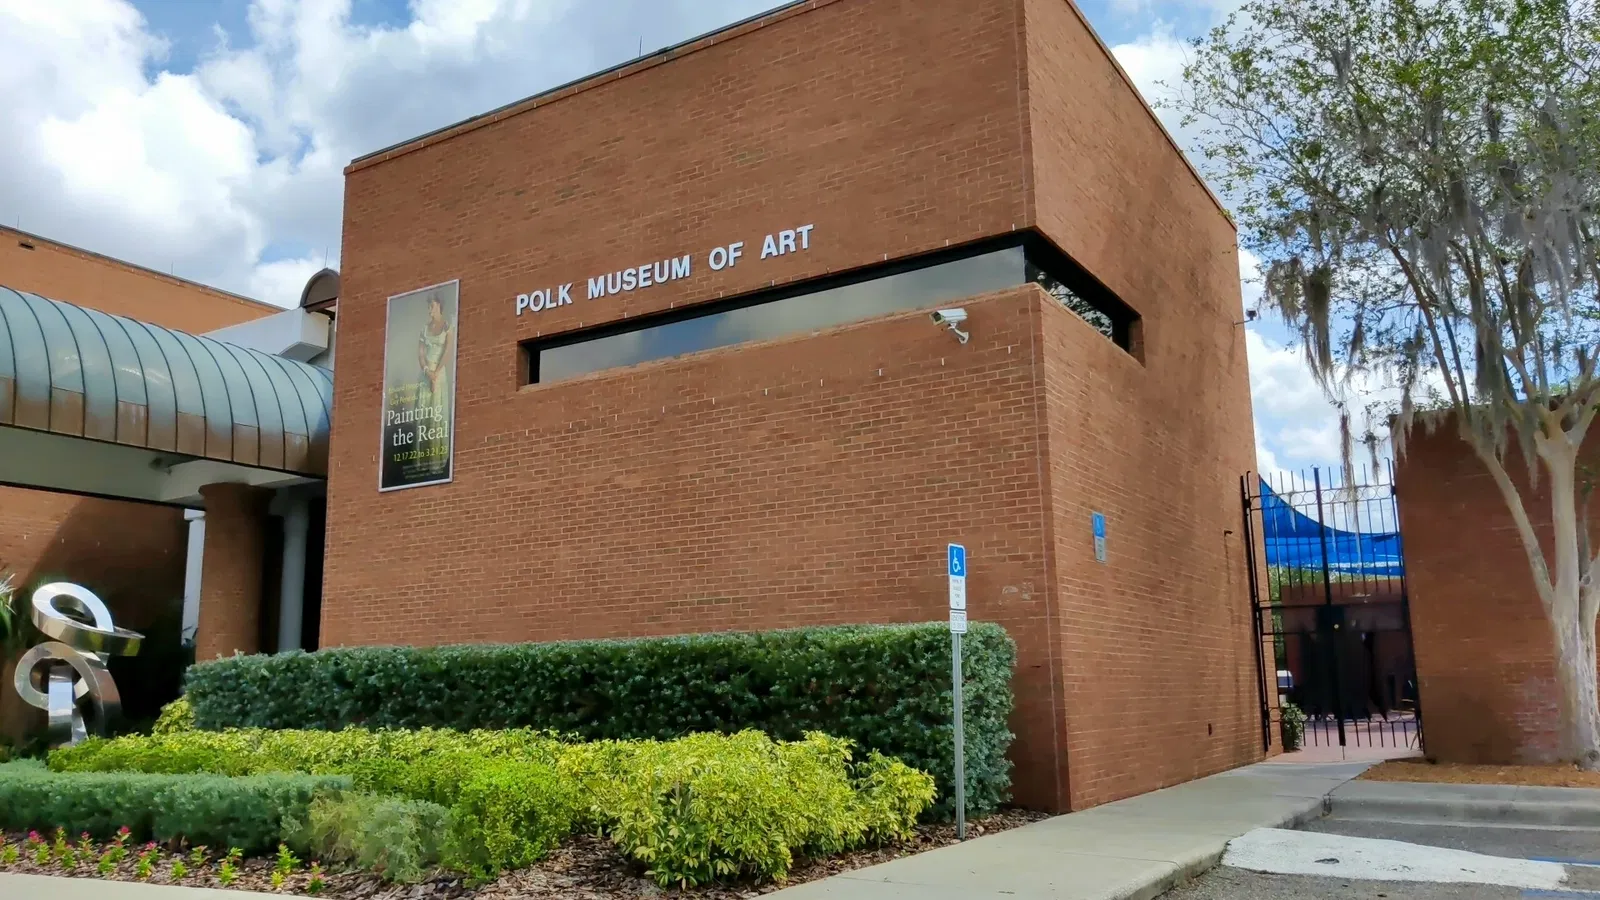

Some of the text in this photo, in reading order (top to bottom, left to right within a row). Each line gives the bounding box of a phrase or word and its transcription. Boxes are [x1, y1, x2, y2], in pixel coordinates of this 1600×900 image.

[516, 223, 814, 316] POLK MUSEUM OF ART
[387, 404, 443, 426] Painting
[393, 421, 449, 446] the Real
[393, 450, 418, 462] 12.17.22
